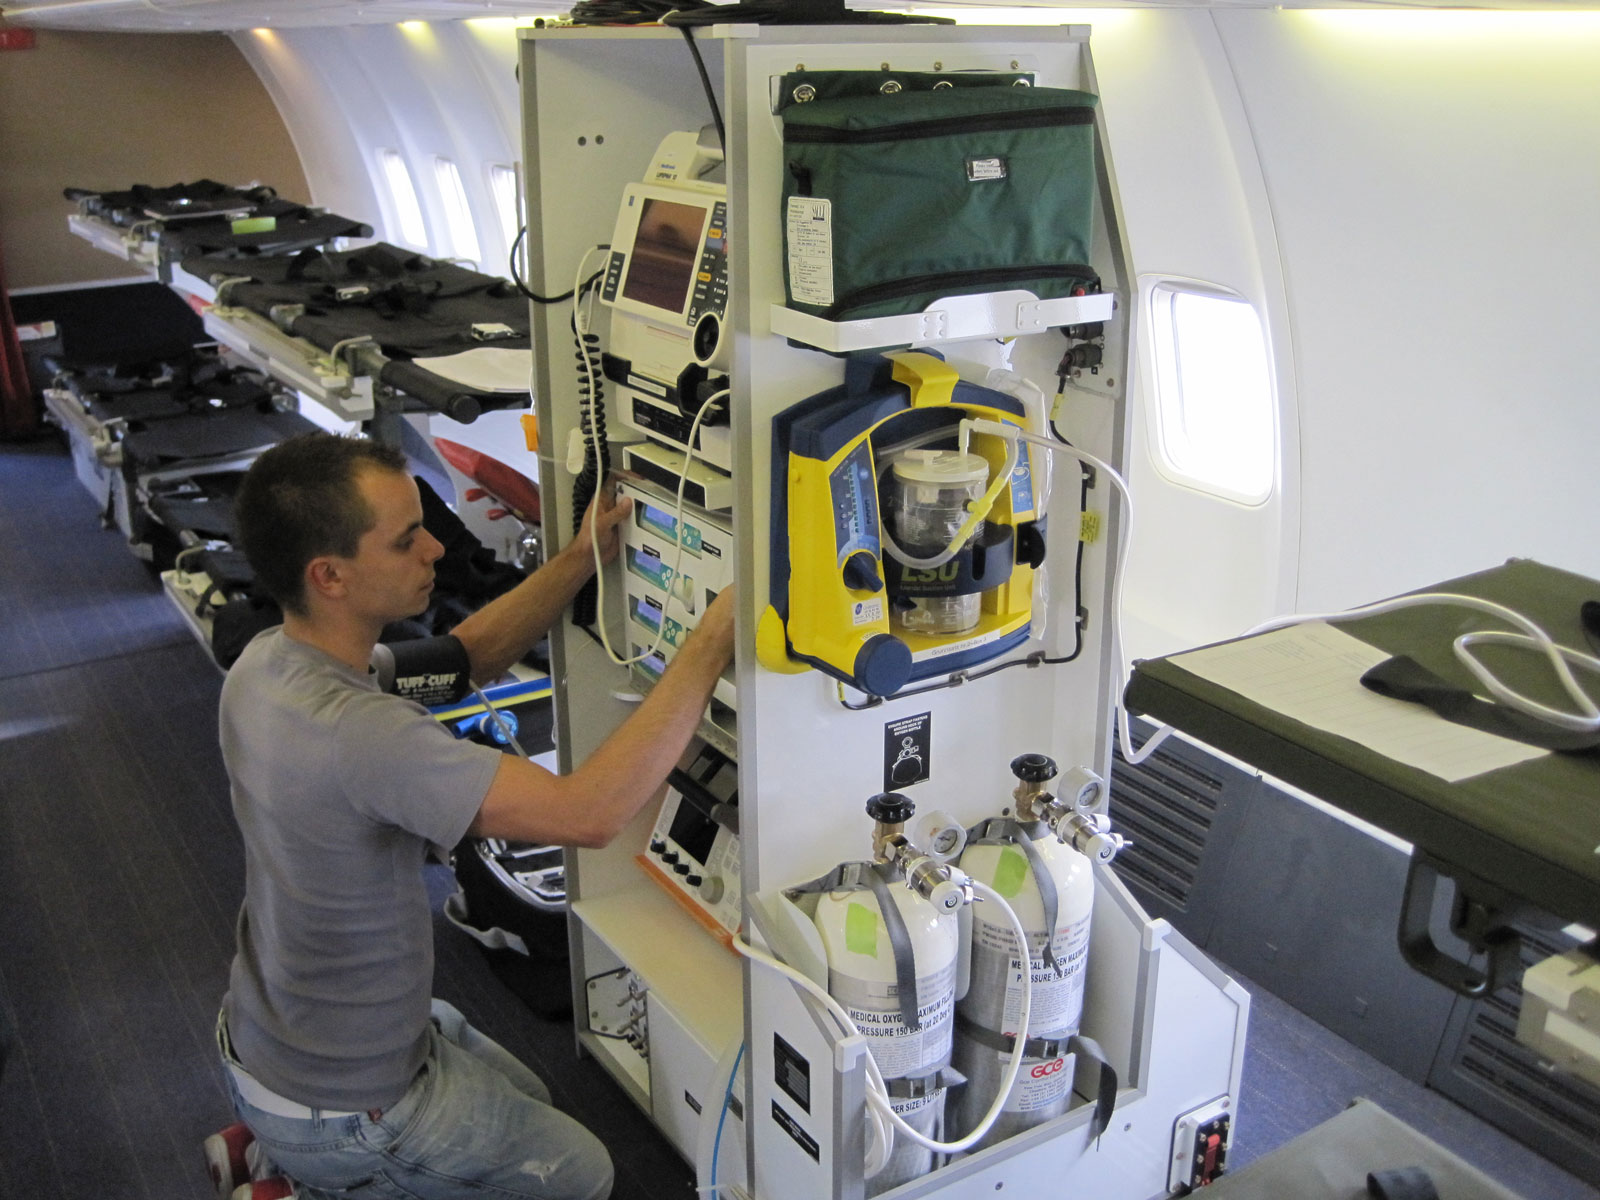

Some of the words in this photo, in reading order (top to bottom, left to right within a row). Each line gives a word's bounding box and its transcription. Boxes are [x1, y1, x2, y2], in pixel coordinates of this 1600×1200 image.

[901, 560, 960, 582] LSU
[396, 676, 424, 690] TUFF
[428, 673, 457, 687] CUFF
[902, 718, 913, 726] STRAP
[1011, 960, 1041, 970] MECAL
[1043, 956, 1067, 969] OXGEN
[1016, 973, 1052, 983] PSSURE
[1064, 965, 1074, 977] BAR
[850, 1010, 881, 1023] MEDICAL
[882, 1014, 902, 1024] OXYG
[917, 1000, 941, 1017] AXIMUM
[856, 1025, 894, 1037] PRESSURE
[895, 1026, 908, 1037] 150
[906, 1100, 922, 1112] SIZE:
